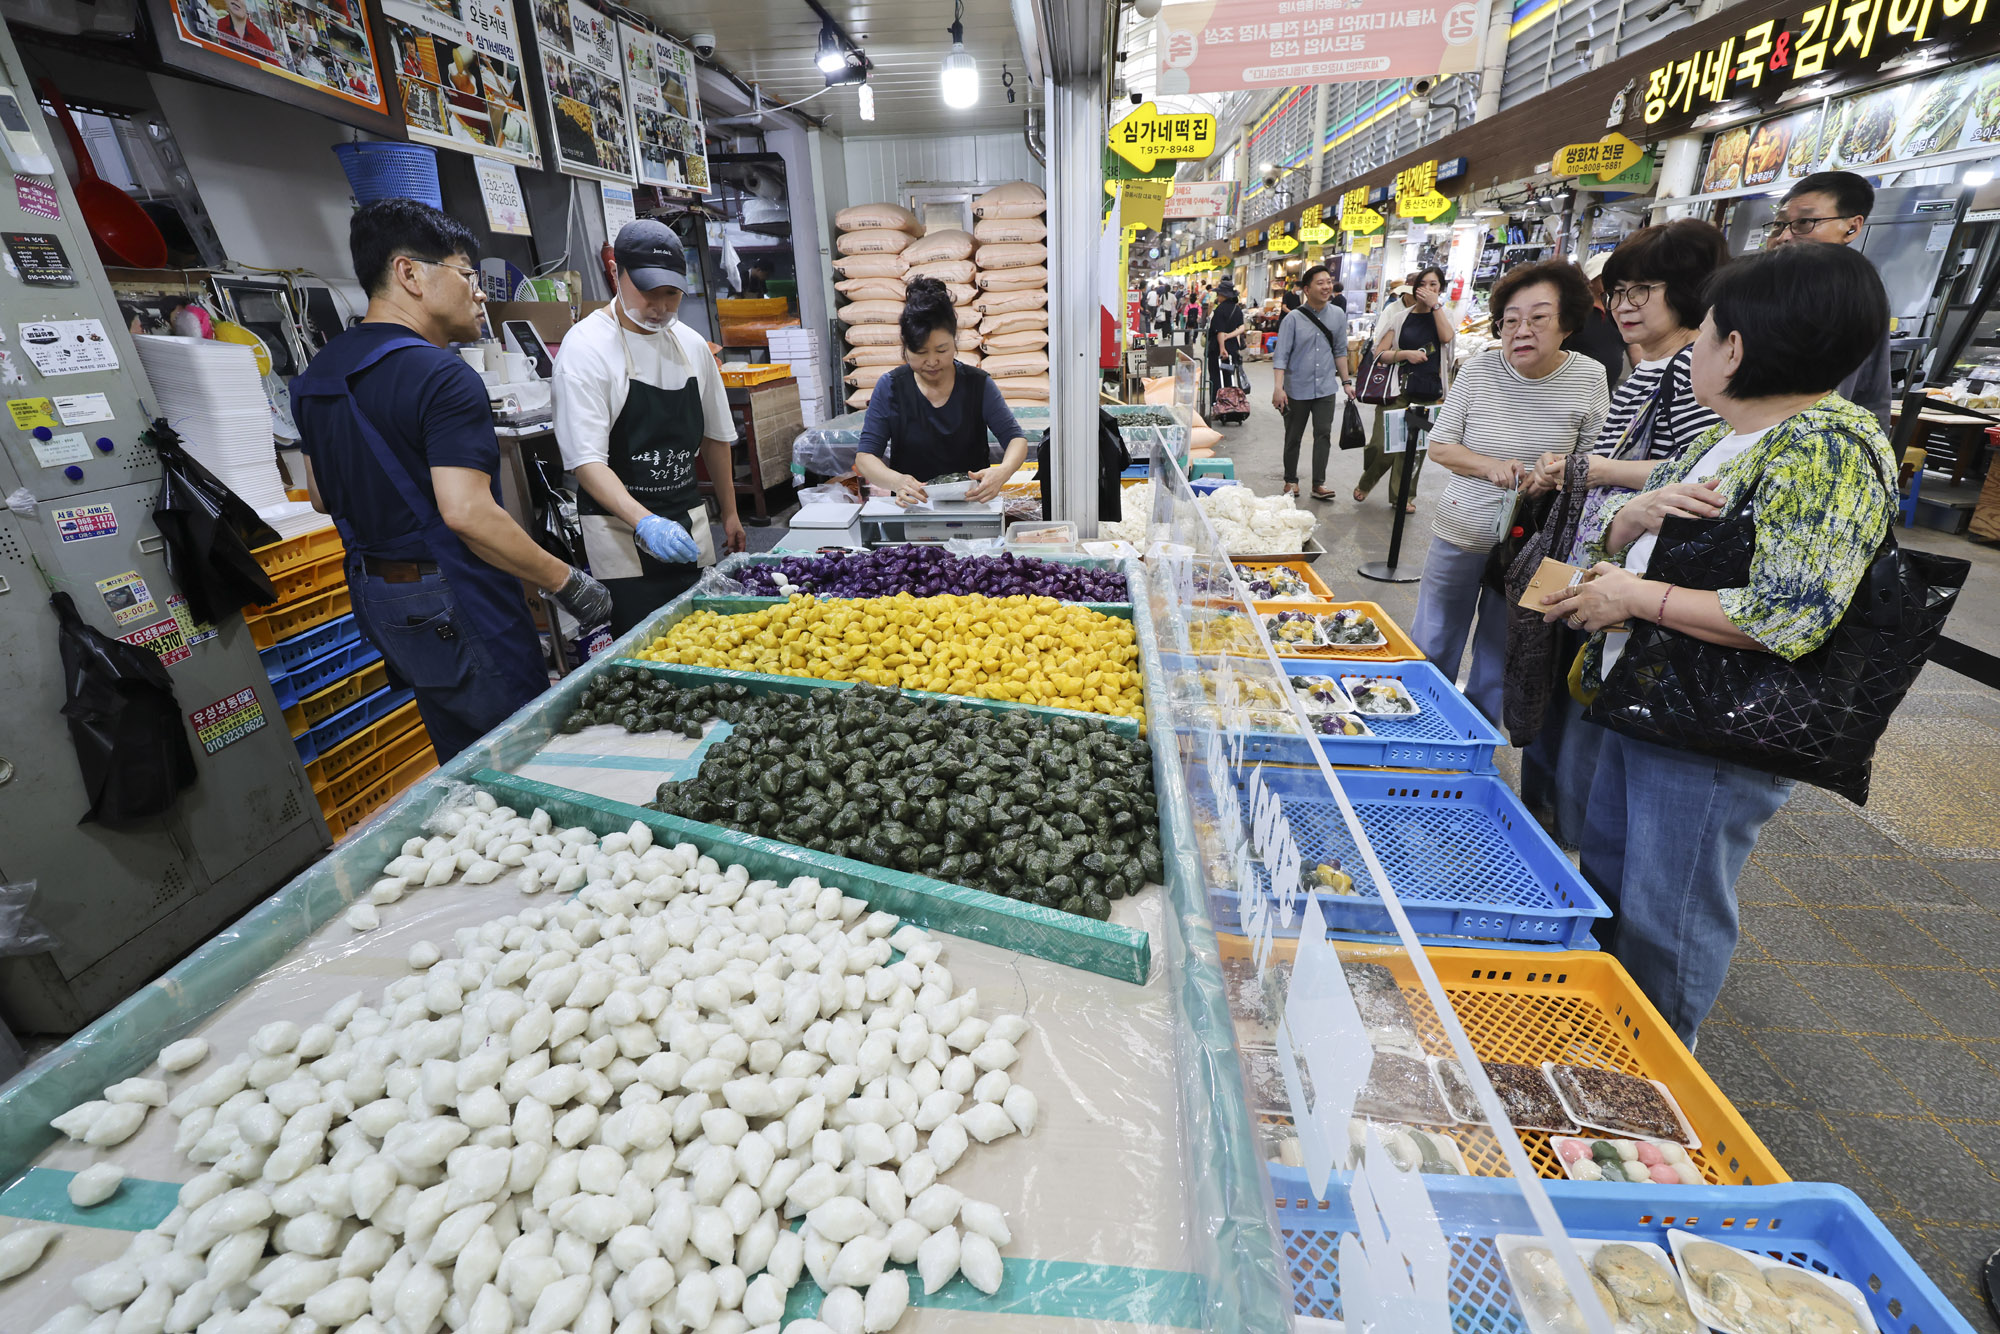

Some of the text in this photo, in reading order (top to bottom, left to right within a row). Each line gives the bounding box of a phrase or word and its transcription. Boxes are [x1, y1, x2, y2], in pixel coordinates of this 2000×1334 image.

[476, 34, 515, 62] 심가네떡집
[1123, 118, 1208, 143] 심가네떡집
[1140, 145, 1195, 155] T.957-8948
[1907, 138, 1939, 153] 파김치
[1566, 143, 1625, 164] 쌍화차 전문
[1567, 162, 1622, 173] 010-8008-6881
[483, 178, 517, 195] 132-132
[488, 192, 518, 207] 992816
[1404, 197, 1444, 210] 동산건어물
[57, 508, 74, 519] 서울
[87, 506, 110, 516] 서비스
[193, 694, 238, 724] 우성냉동
